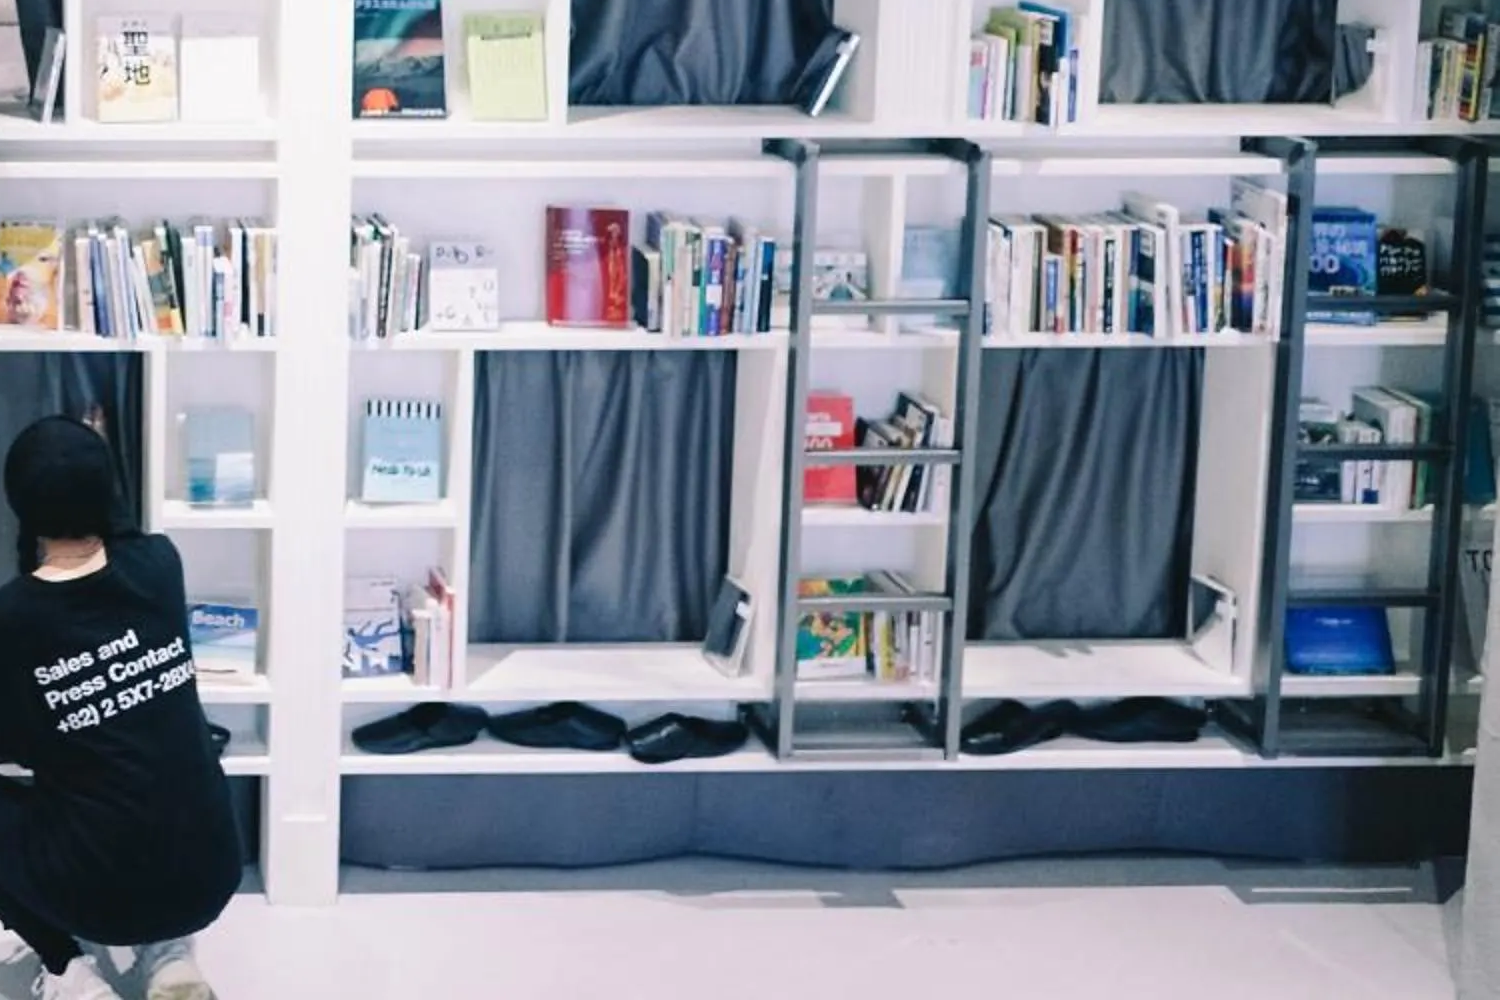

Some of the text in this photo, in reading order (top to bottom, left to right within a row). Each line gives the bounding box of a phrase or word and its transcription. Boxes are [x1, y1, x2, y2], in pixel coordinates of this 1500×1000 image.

[122, 30, 151, 86] 聖地
[192, 610, 245, 628] Beach
[34, 628, 139, 686] Sales and
[44, 636, 186, 710] Press Contact
[56, 703, 101, 733] +82)
[100, 698, 117, 719] 2
